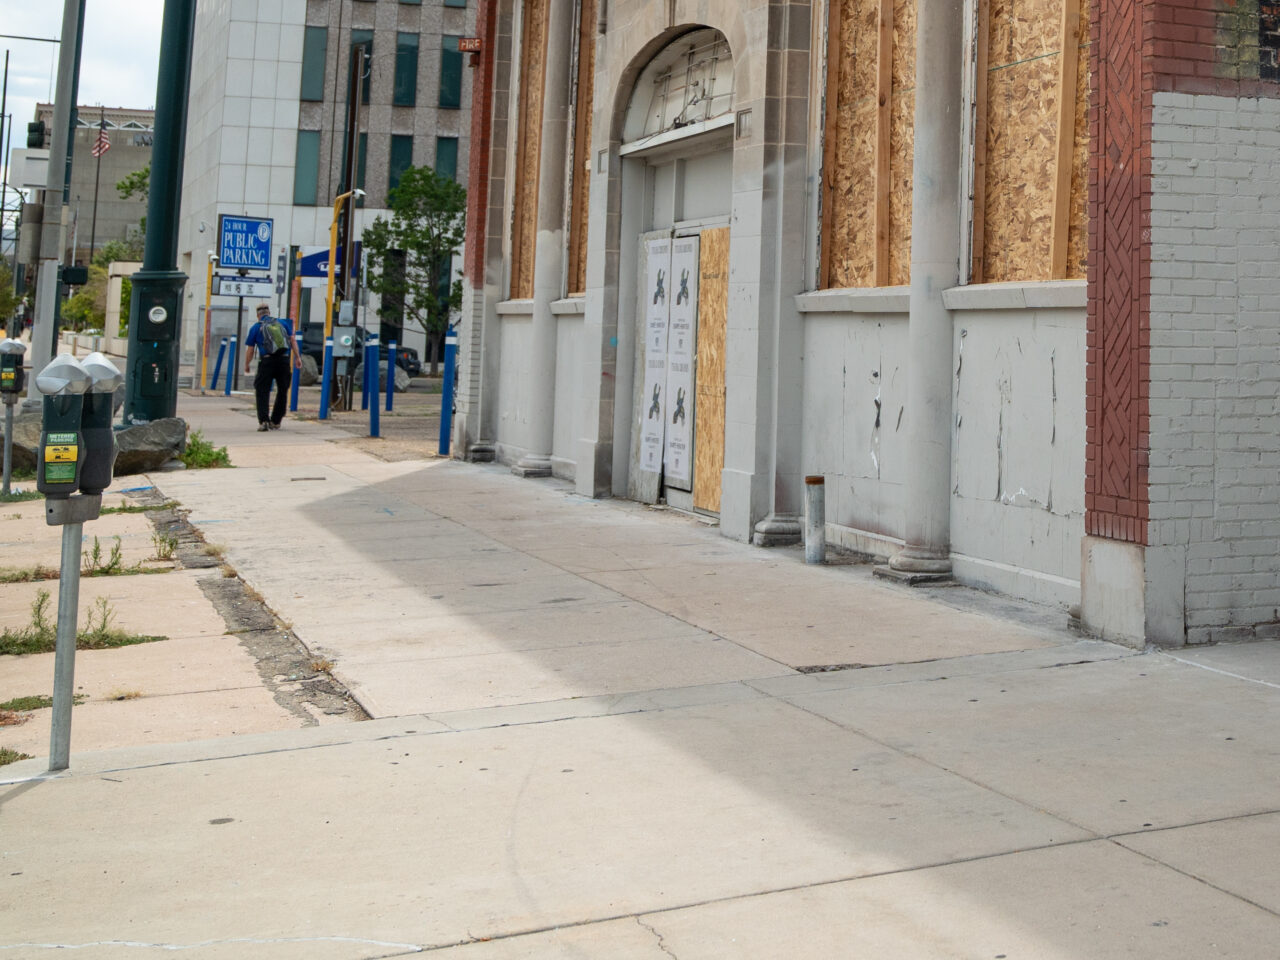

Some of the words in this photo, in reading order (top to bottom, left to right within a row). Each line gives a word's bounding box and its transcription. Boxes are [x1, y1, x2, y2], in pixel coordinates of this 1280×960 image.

[461, 39, 481, 49] FIRE
[224, 231, 258, 249] PUBLIC
[223, 248, 266, 266] PARKING
